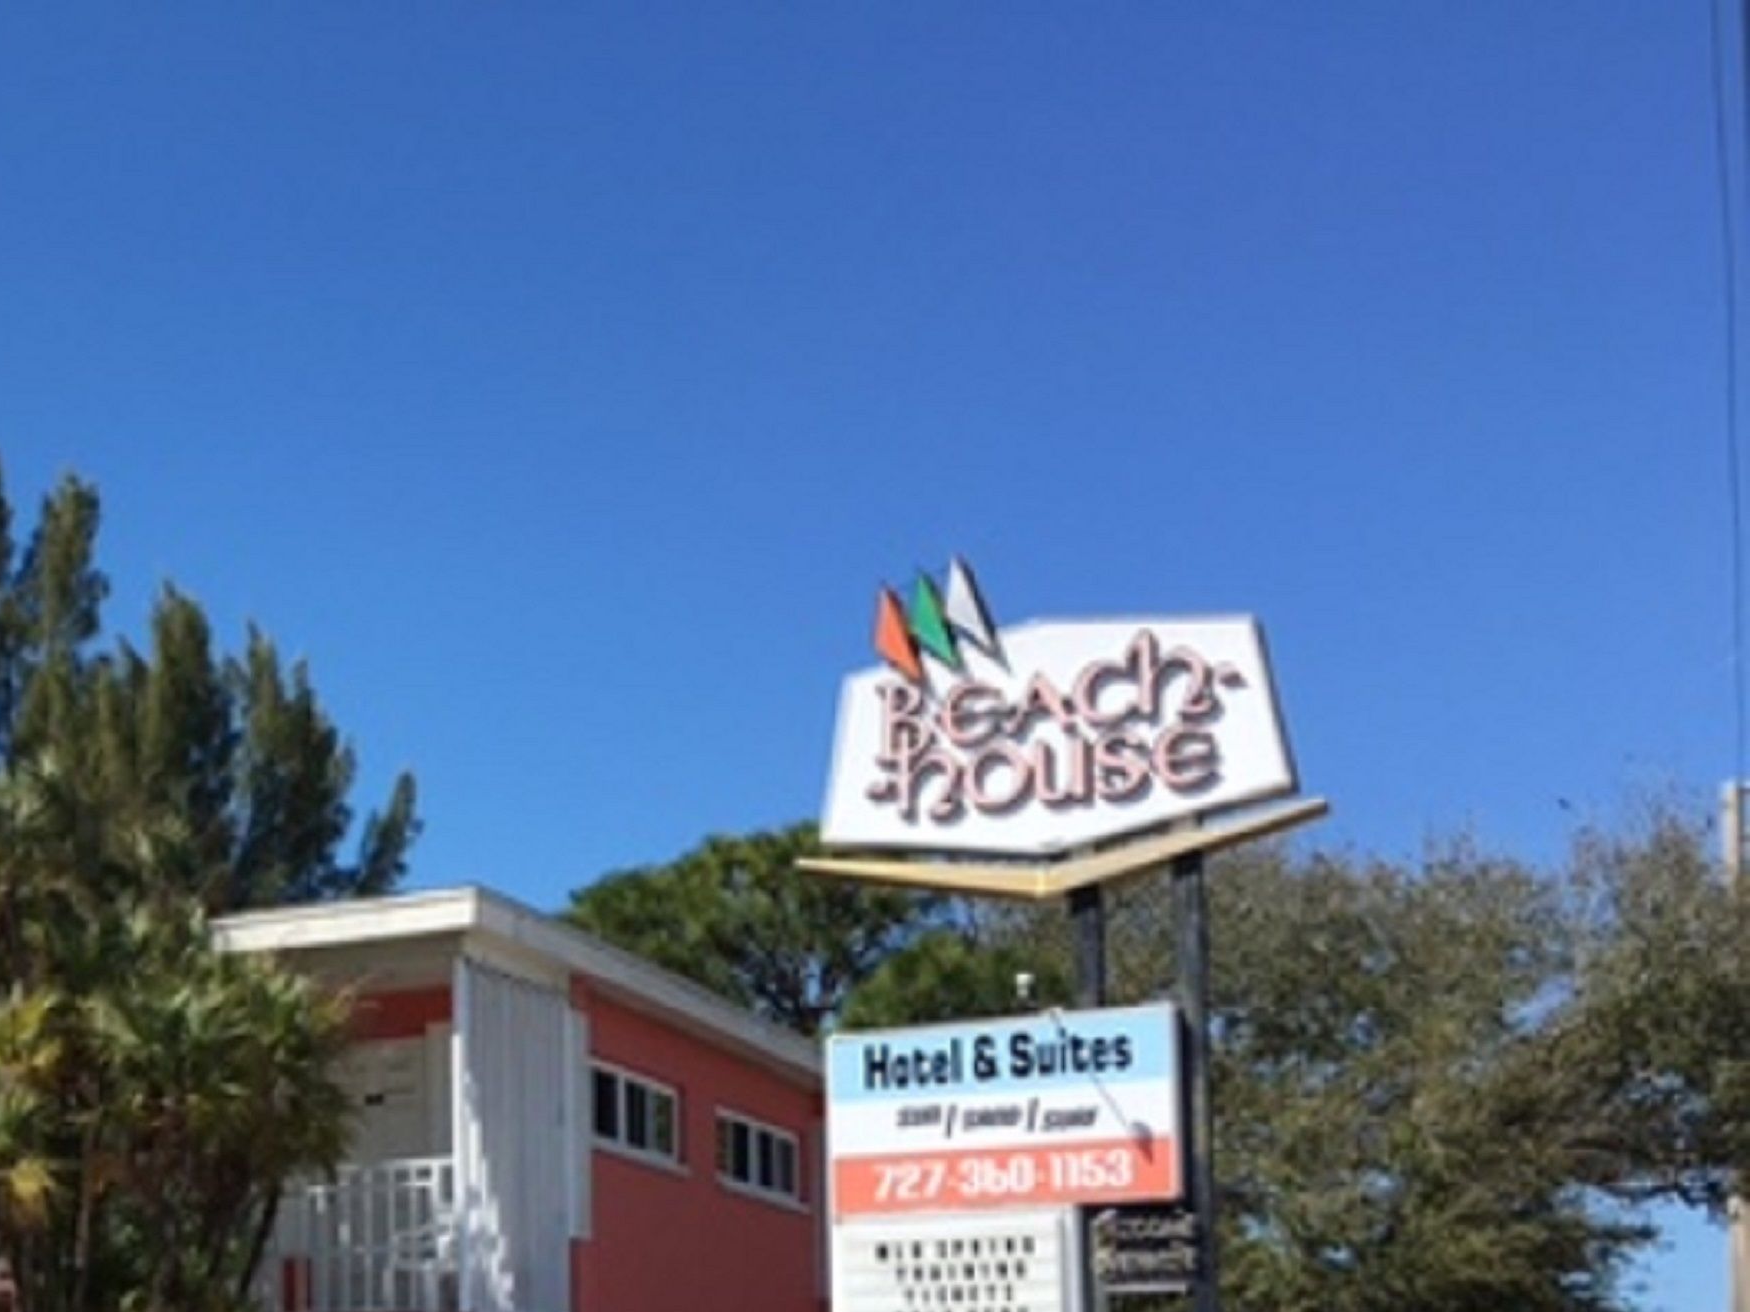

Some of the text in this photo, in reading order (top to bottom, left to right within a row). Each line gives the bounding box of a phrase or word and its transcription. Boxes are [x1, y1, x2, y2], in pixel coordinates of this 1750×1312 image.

[863, 1028, 1132, 1090] Hotel & Suites
[874, 1149, 1133, 1200] 727-360-1153
